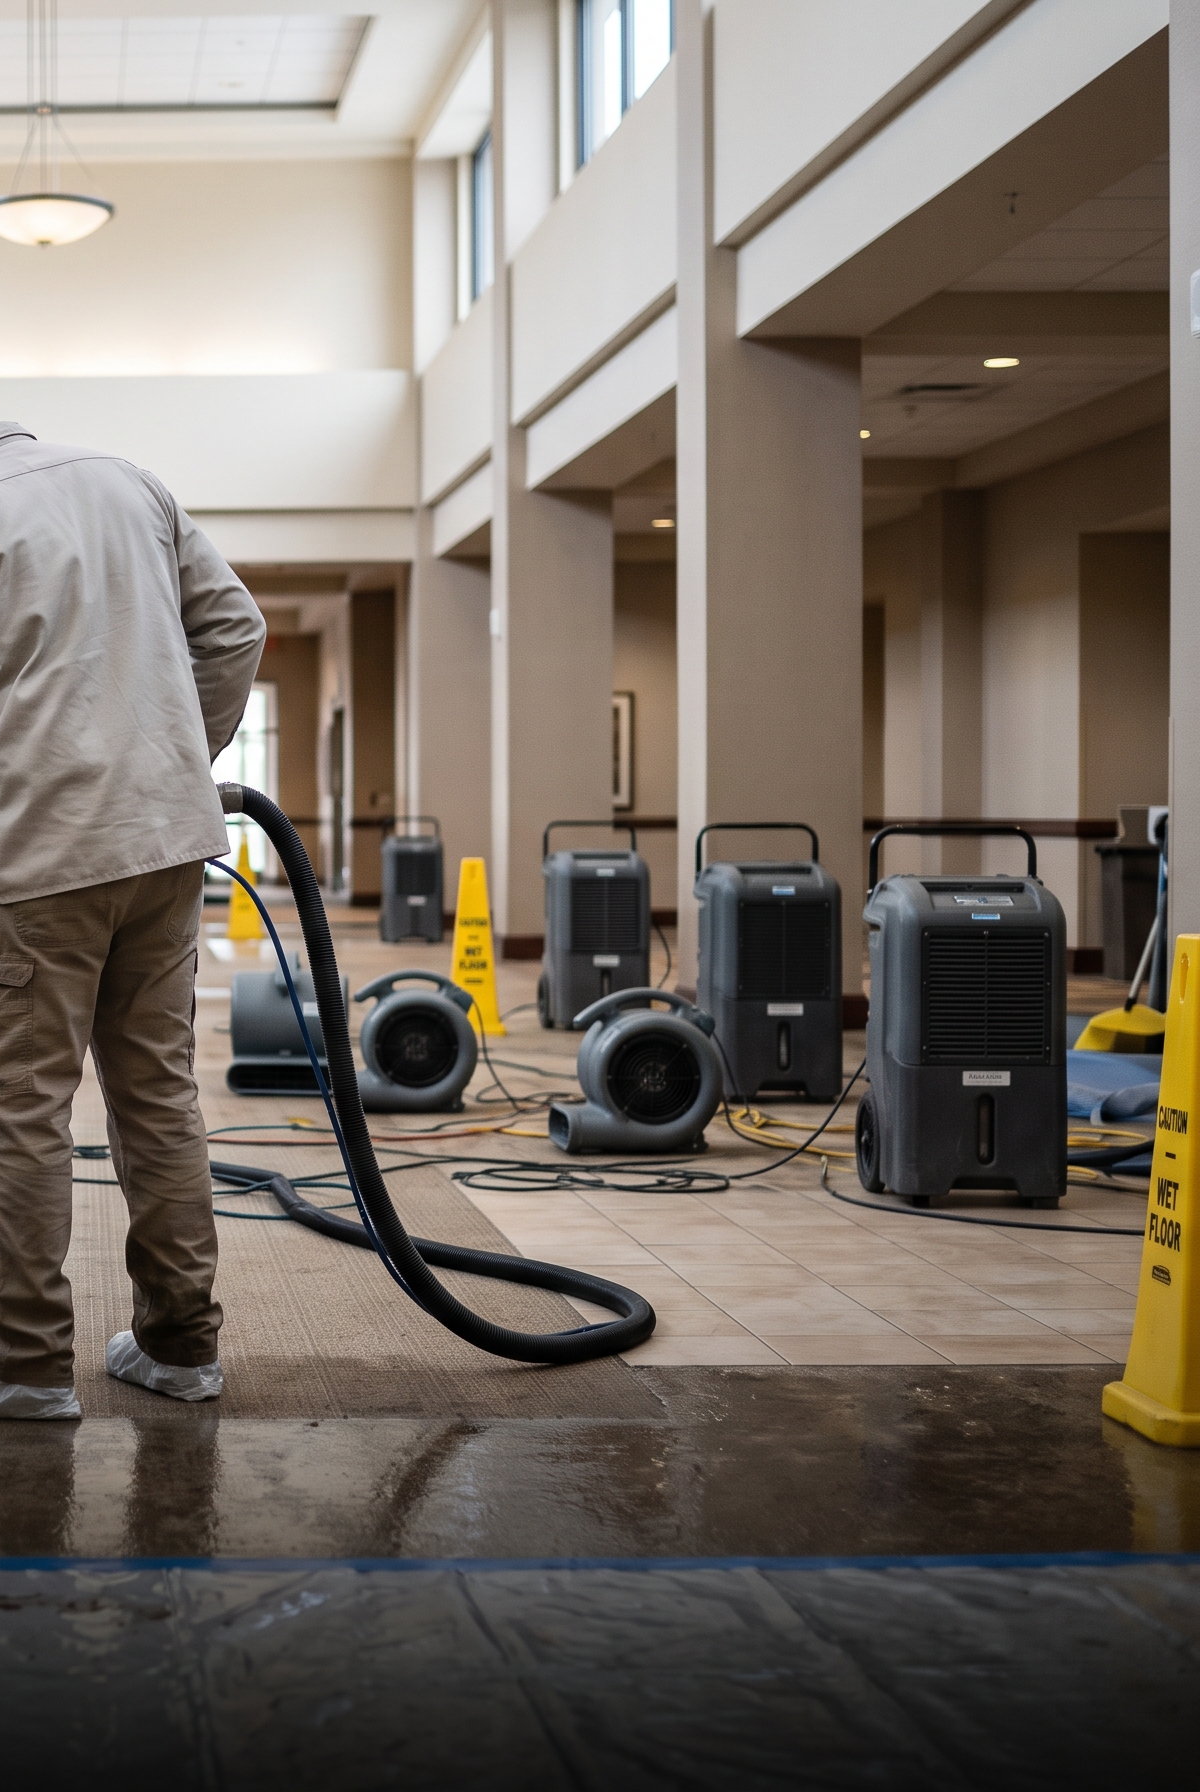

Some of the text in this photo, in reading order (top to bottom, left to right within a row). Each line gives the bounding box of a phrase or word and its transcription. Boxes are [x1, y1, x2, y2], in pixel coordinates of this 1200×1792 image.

[1158, 1105, 1188, 1135] CAUTION
[1157, 1177, 1179, 1211] WET
[1149, 1212, 1181, 1252] FLOOR
